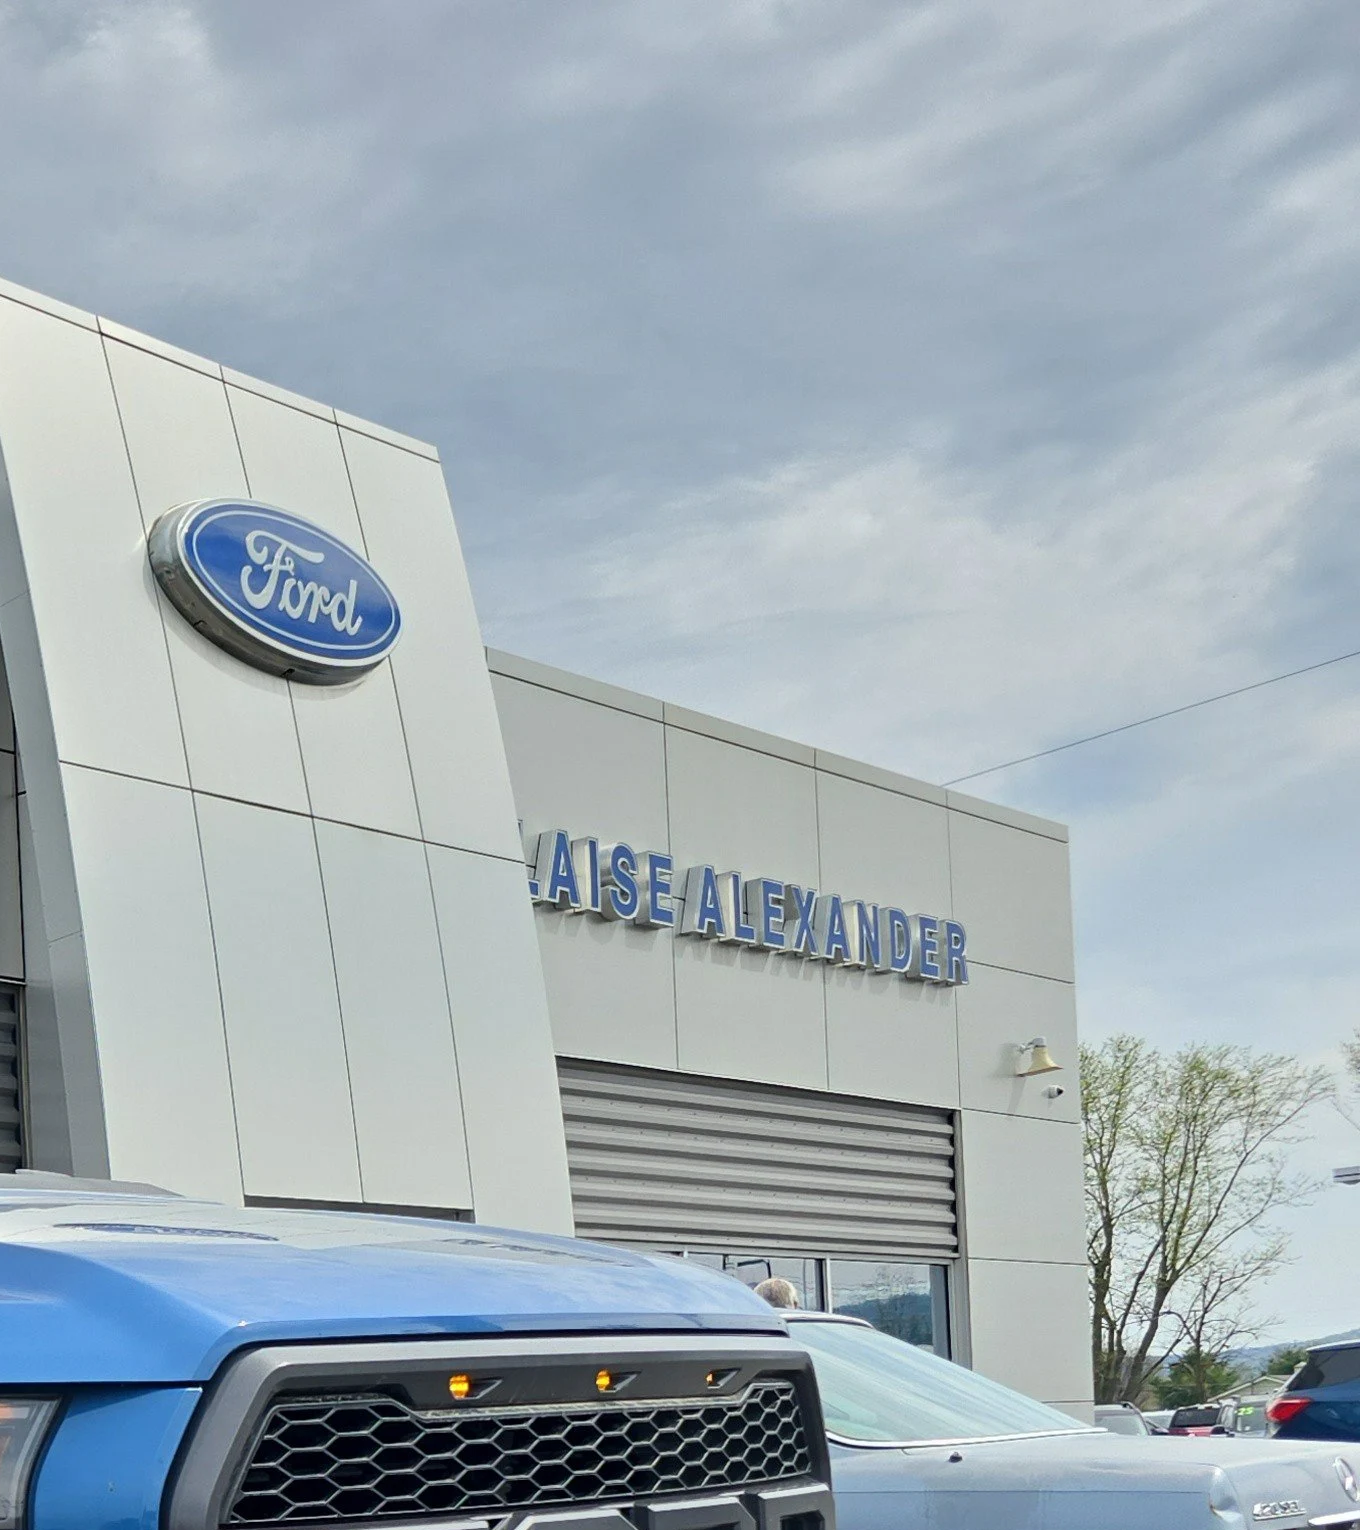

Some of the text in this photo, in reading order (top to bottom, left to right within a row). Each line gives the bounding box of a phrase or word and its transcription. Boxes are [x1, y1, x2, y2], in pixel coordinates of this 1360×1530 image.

[240, 529, 363, 636] Ford
[526, 829, 970, 985] AISE ALEXANDER
